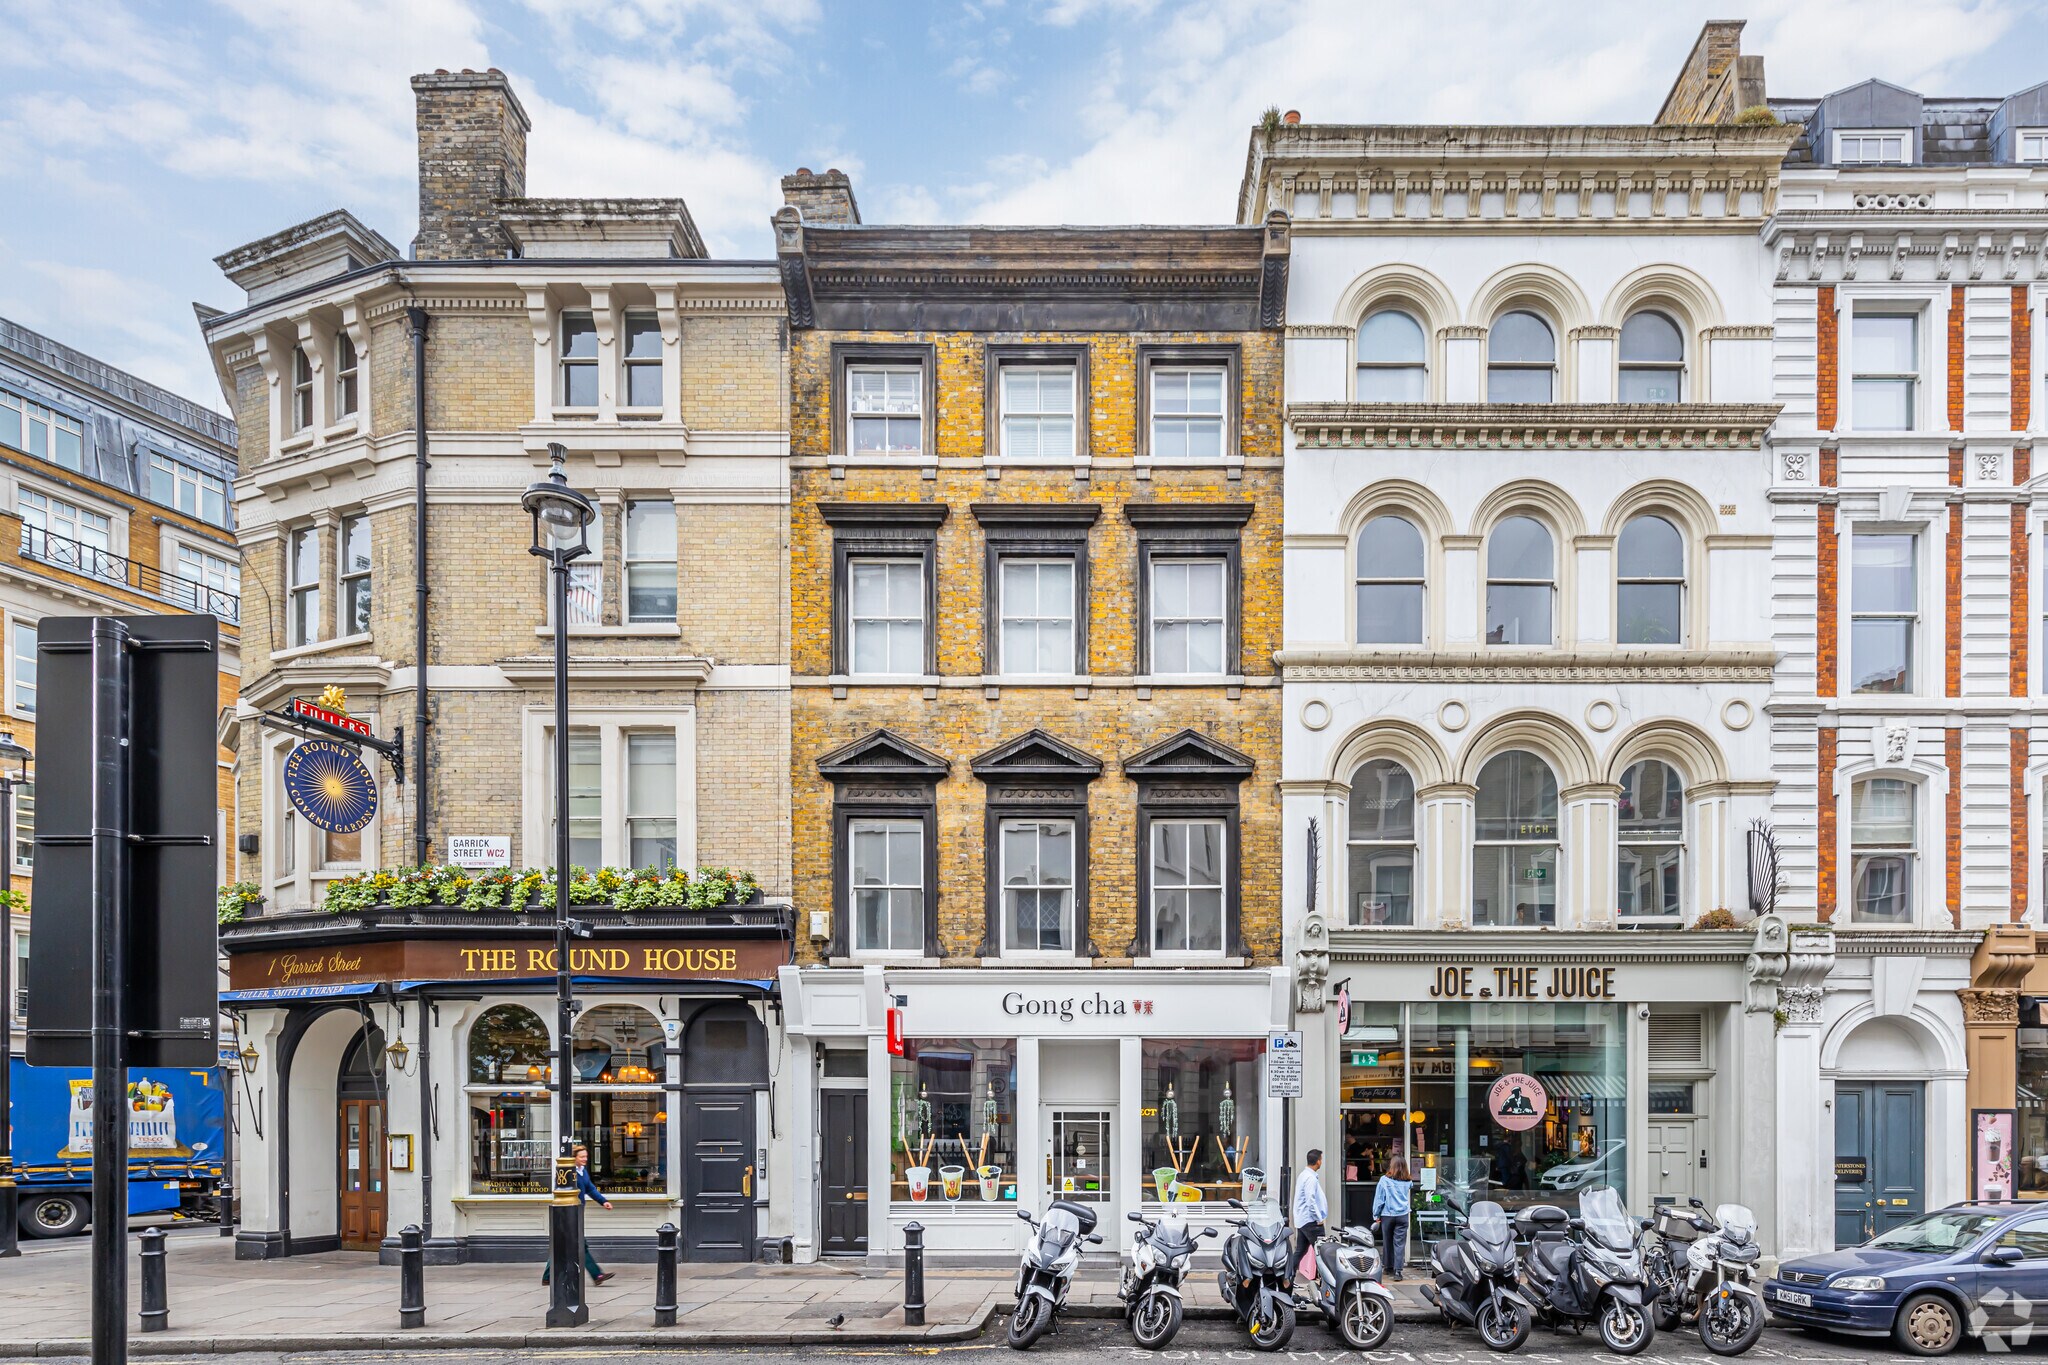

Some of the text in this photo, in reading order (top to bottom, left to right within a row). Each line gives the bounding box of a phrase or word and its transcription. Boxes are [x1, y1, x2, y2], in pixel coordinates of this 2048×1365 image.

[287, 741, 377, 803] THE ROUND HOUSE
[290, 789, 373, 832] COVENT GARDEN
[453, 839, 490, 848] GARRICK
[453, 848, 505, 857] STREET WC2
[267, 951, 362, 983] 1 Garrick Street
[460, 948, 737, 971] THE ROUND HOUSE
[237, 985, 345, 999] FULLER, SMITH & TURNER
[1429, 966, 1616, 998] JOE & THE JUICE
[1002, 991, 1128, 1023] Gong cha
[1493, 1083, 1505, 1097] JOE
[1524, 1080, 1543, 1097] JUICE
[1794, 1294, 1807, 1305] GRK
[1129, 1350, 1256, 1360] SOLO
